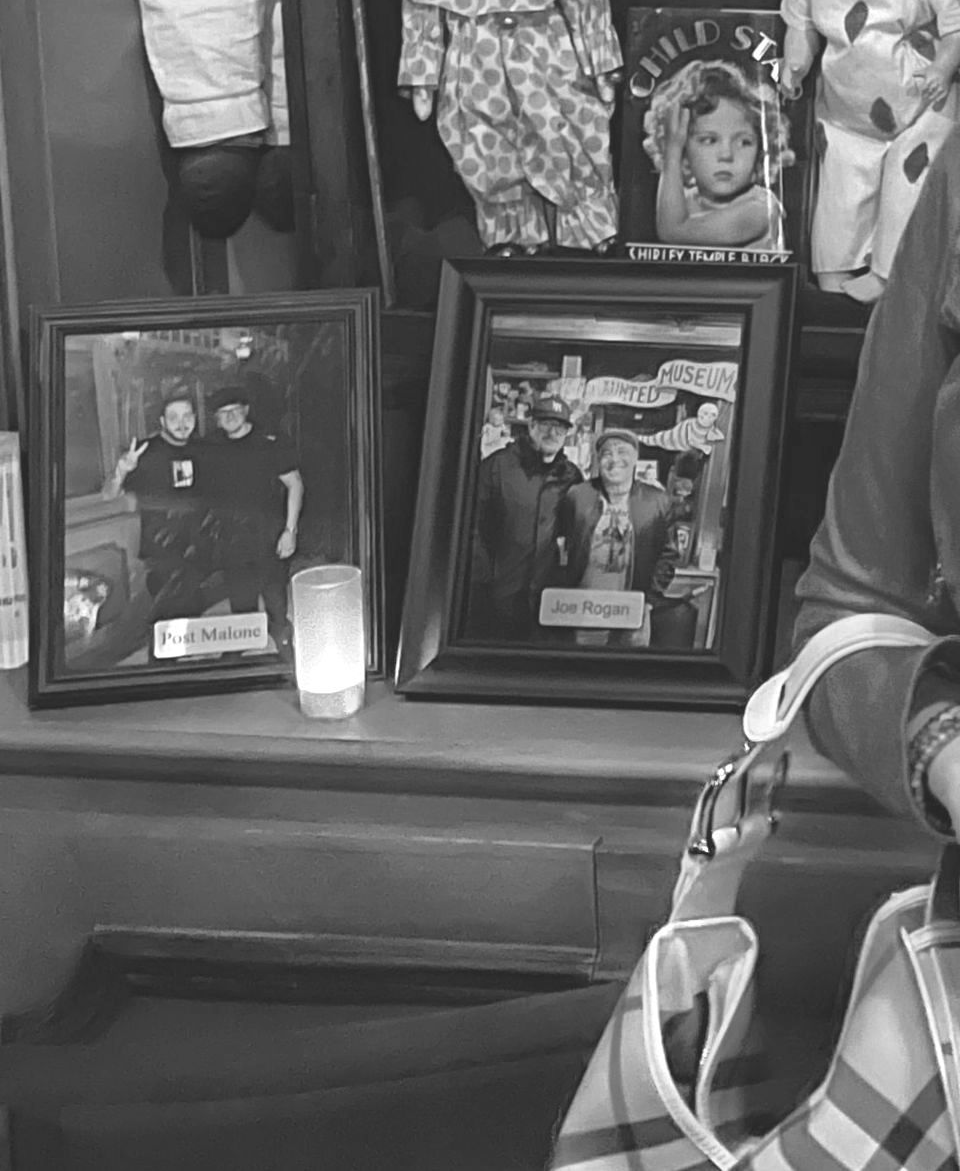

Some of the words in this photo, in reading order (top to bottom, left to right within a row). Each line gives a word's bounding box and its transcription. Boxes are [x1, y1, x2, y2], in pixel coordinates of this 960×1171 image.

[630, 19, 721, 98] CHILD
[660, 363, 735, 394] MUSEUM
[551, 599, 578, 614] Joe
[582, 600, 630, 619] Rogan
[162, 631, 196, 645] Post
[201, 626, 261, 642] Malone
